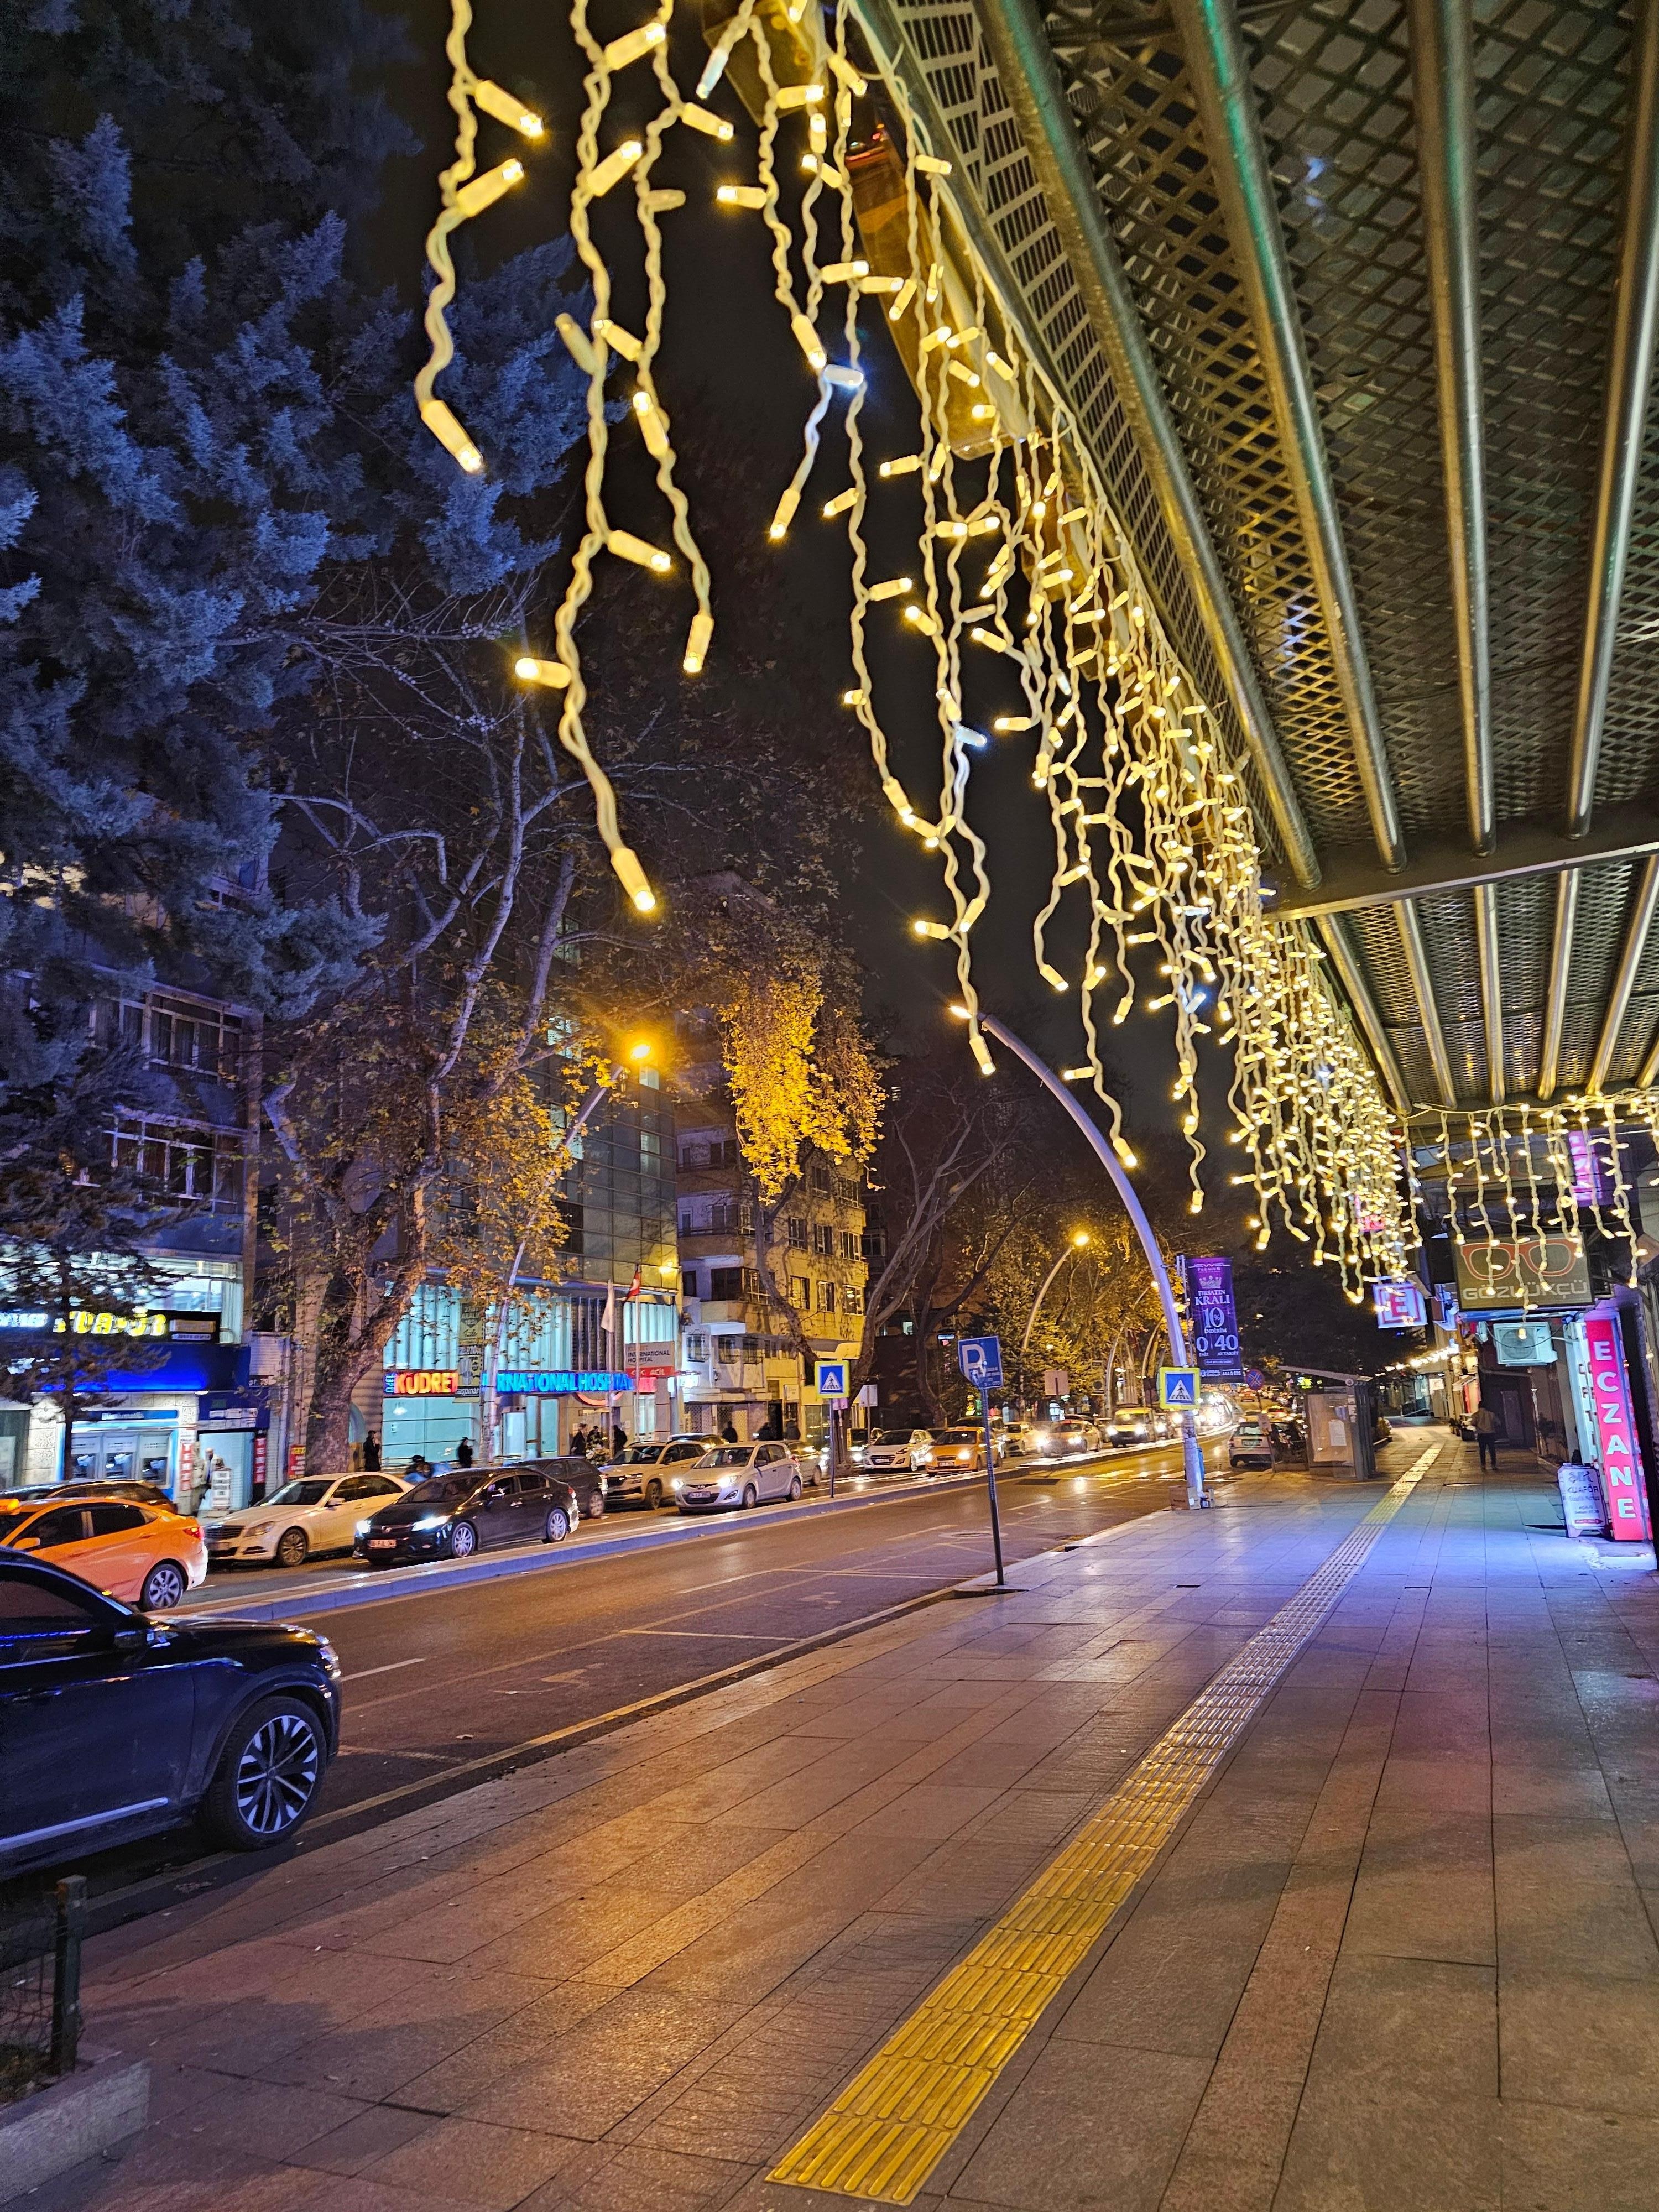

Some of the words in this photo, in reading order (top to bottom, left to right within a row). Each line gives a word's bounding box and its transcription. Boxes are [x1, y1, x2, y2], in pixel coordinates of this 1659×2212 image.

[1195, 1295, 1230, 1305] KRALI
[1214, 1334, 1239, 1351] 40
[1593, 1341, 1636, 1519] ECZANE
